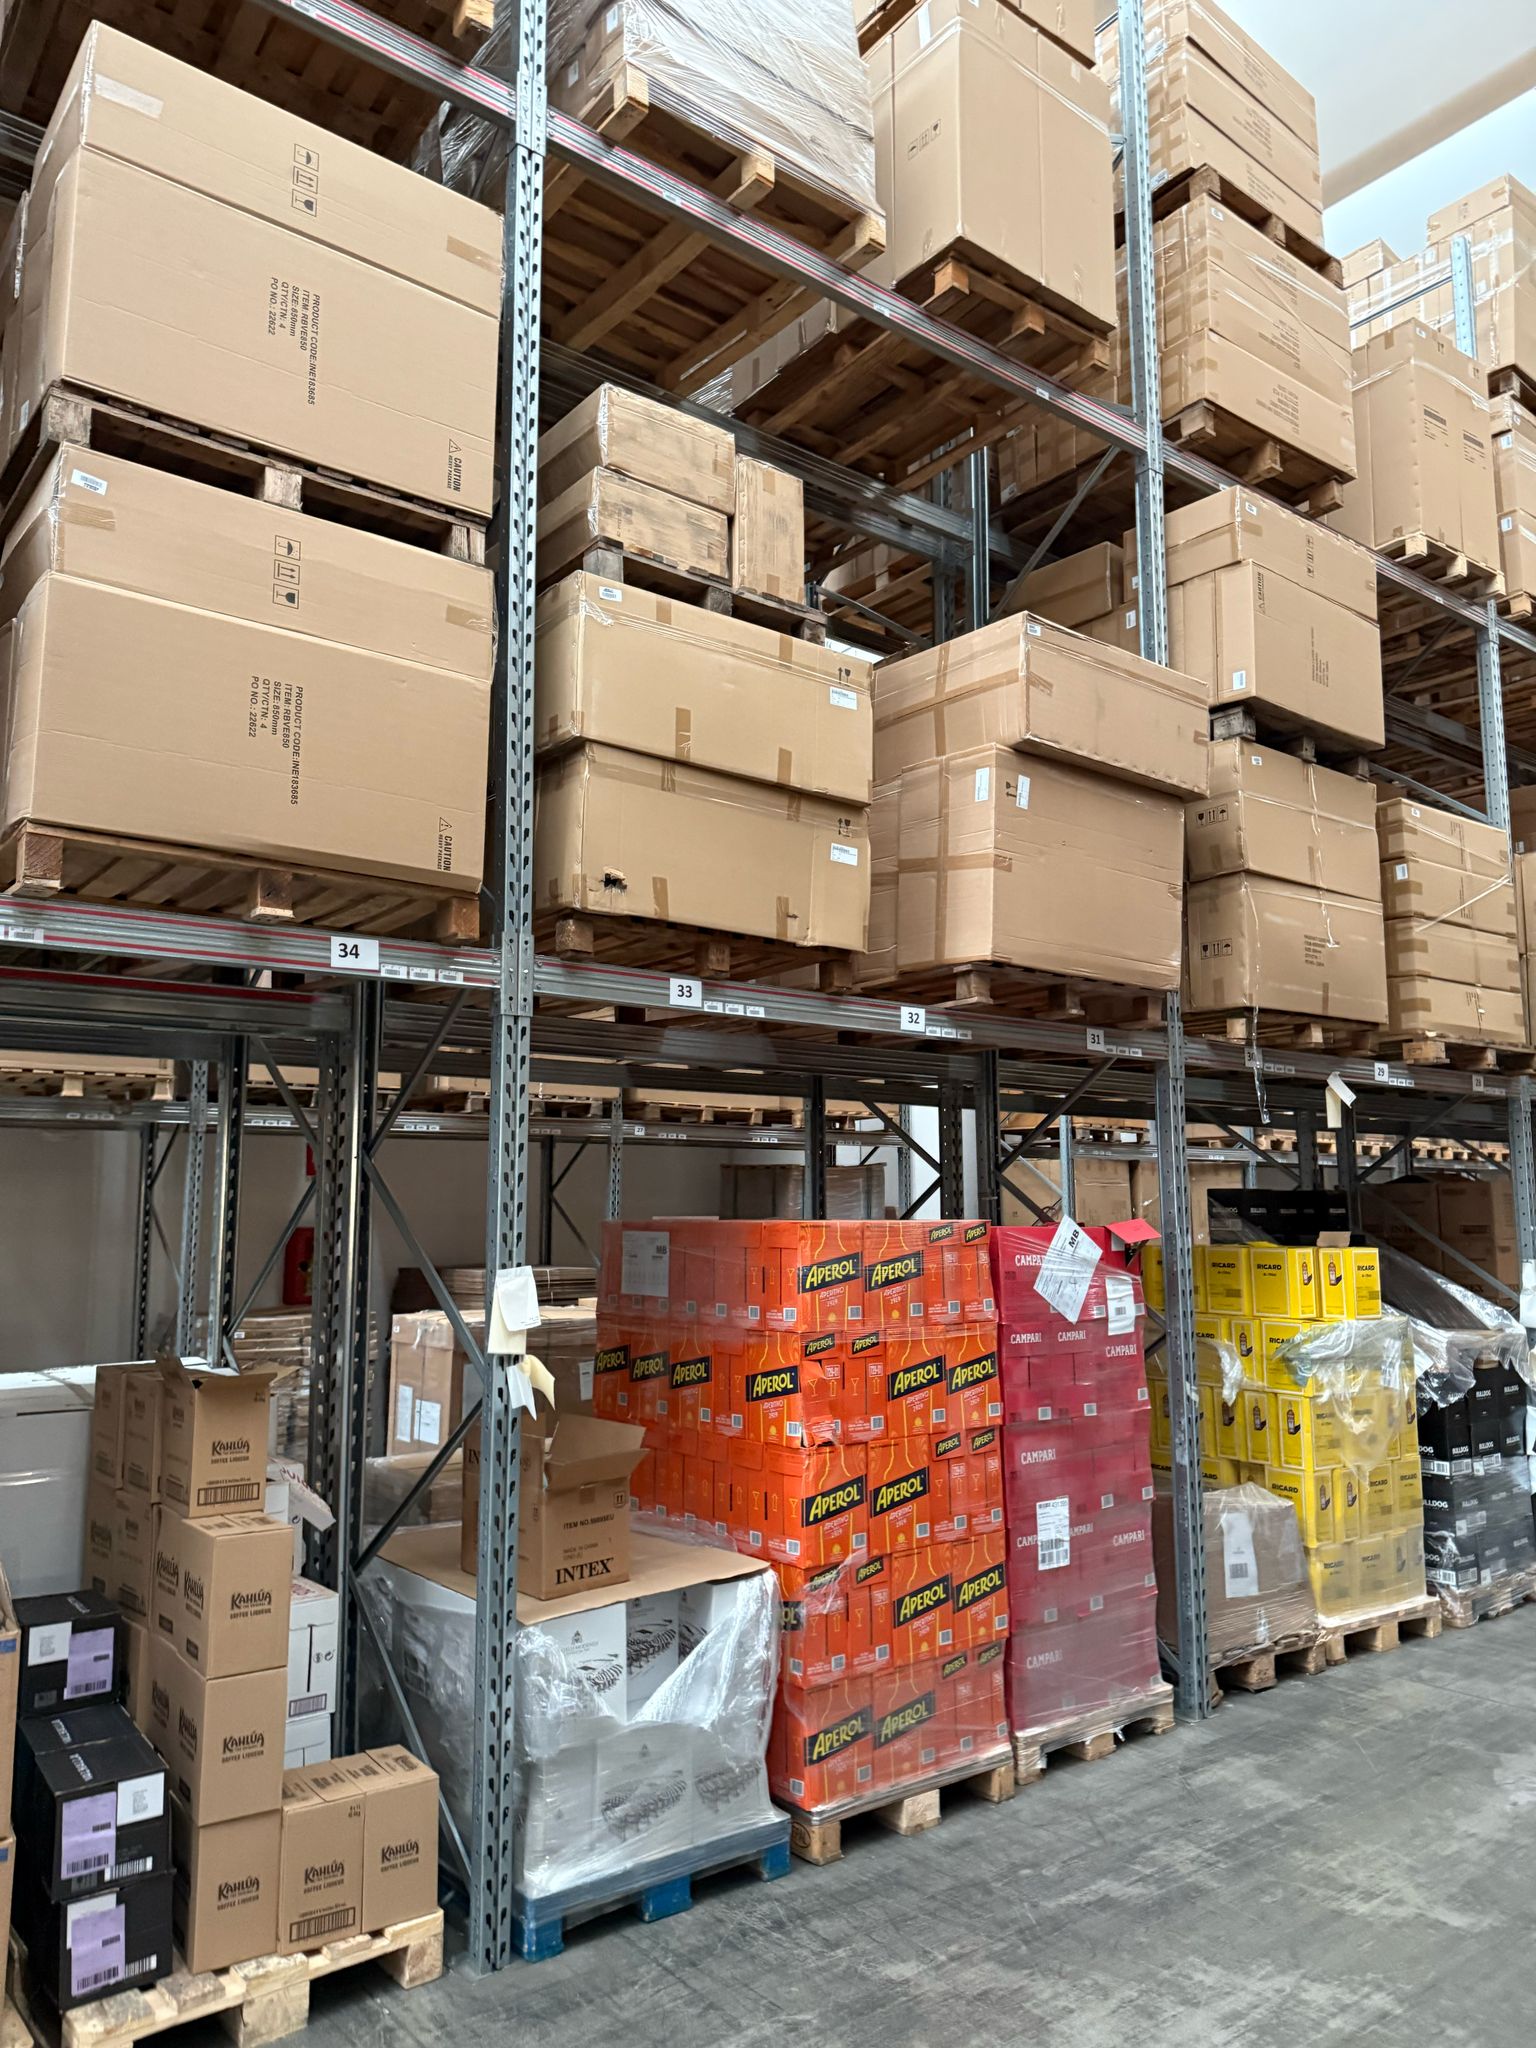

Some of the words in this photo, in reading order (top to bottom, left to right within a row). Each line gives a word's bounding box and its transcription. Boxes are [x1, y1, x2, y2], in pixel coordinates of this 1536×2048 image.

[271, 277, 278, 290] PO
[280, 281, 289, 322] QTY/CTN:
[312, 294, 320, 335] PRODUCT
[453, 458, 462, 492] CAUTION
[251, 676, 259, 689] PO
[261, 678, 270, 721] QTY/CTN:
[294, 686, 303, 731] PRODUCT
[248, 712, 257, 738] 22622
[290, 732, 300, 805] CODE:INE183685
[443, 836, 452, 871] CAUTION
[338, 943, 360, 959] 34
[677, 984, 692, 998] 33
[908, 1012, 920, 1024] 32
[1090, 1034, 1101, 1044] 31
[1378, 1067, 1384, 1076] 29
[931, 1226, 952, 1241] APEROL
[966, 1224, 986, 1241] APEROL
[1068, 1230, 1080, 1248] MB
[656, 1245, 667, 1255] MB
[805, 1261, 855, 1288] APEROL
[871, 1258, 917, 1287] APEROL
[806, 1337, 833, 1355] APEROL
[854, 1335, 878, 1352] APEROL
[1011, 1333, 1042, 1344] CAMPARI
[1058, 1330, 1086, 1342] CAMPARI
[1106, 1344, 1137, 1357] CAMPARI
[597, 1352, 625, 1372] APEROL
[633, 1357, 664, 1379] APEROL
[673, 1362, 707, 1385] APEROL
[894, 1368, 939, 1396] APEROL
[952, 1359, 994, 1390] APEROL
[753, 1373, 794, 1399] APEROL
[1504, 1384, 1519, 1393] BULLDOG
[212, 1438, 250, 1456] KAHLÚA
[937, 1438, 960, 1454] APEROL
[973, 1432, 995, 1450] APEROL
[1452, 1446, 1468, 1454] BULLDOG
[1021, 1449, 1056, 1465] CAMPARI
[876, 1476, 923, 1512] APEROL
[1272, 1483, 1298, 1493] RICARD
[809, 1486, 860, 1522] APEROL
[1113, 1530, 1144, 1547] CAMPARI
[555, 1557, 612, 1585] INTEX
[858, 1560, 883, 1580] APEROL
[231, 1589, 272, 1610] KAHLÚA
[959, 1571, 1001, 1608] APEROL
[900, 1588, 946, 1622] APEROL
[943, 1656, 966, 1676] APEROL
[1027, 1650, 1062, 1669] CAMPARI
[881, 1701, 928, 1742] APEROL
[223, 1731, 264, 1754] KAHLÚA
[813, 1717, 864, 1760] APEROL
[381, 1840, 419, 1864] KAHLÚA
[304, 1860, 345, 1884] KAHLÚA
[218, 1876, 260, 1900] KAHLÚA
